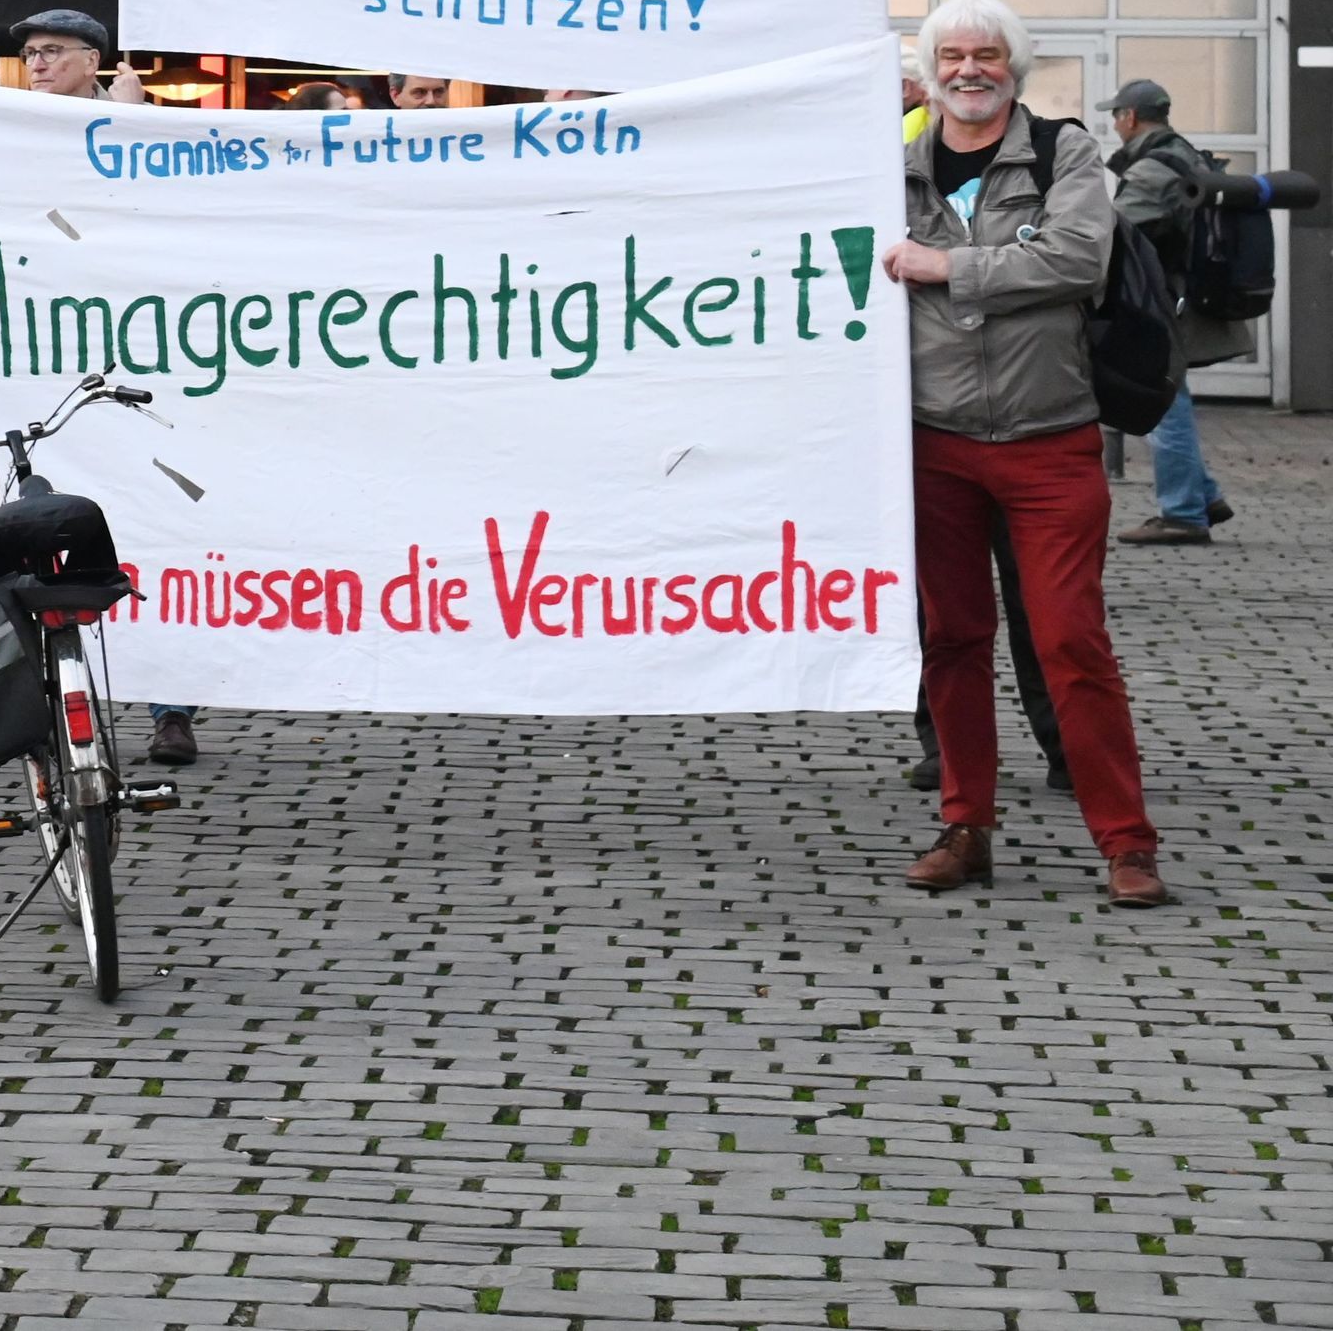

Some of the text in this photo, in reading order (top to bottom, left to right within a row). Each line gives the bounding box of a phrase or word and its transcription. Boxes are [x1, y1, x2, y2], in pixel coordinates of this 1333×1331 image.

[84, 116, 270, 181] Grannies
[320, 113, 486, 169] Future
[513, 106, 643, 160] Köln
[159, 553, 364, 636] müssen
[380, 543, 471, 634] die
[484, 510, 900, 639] Verursacher
